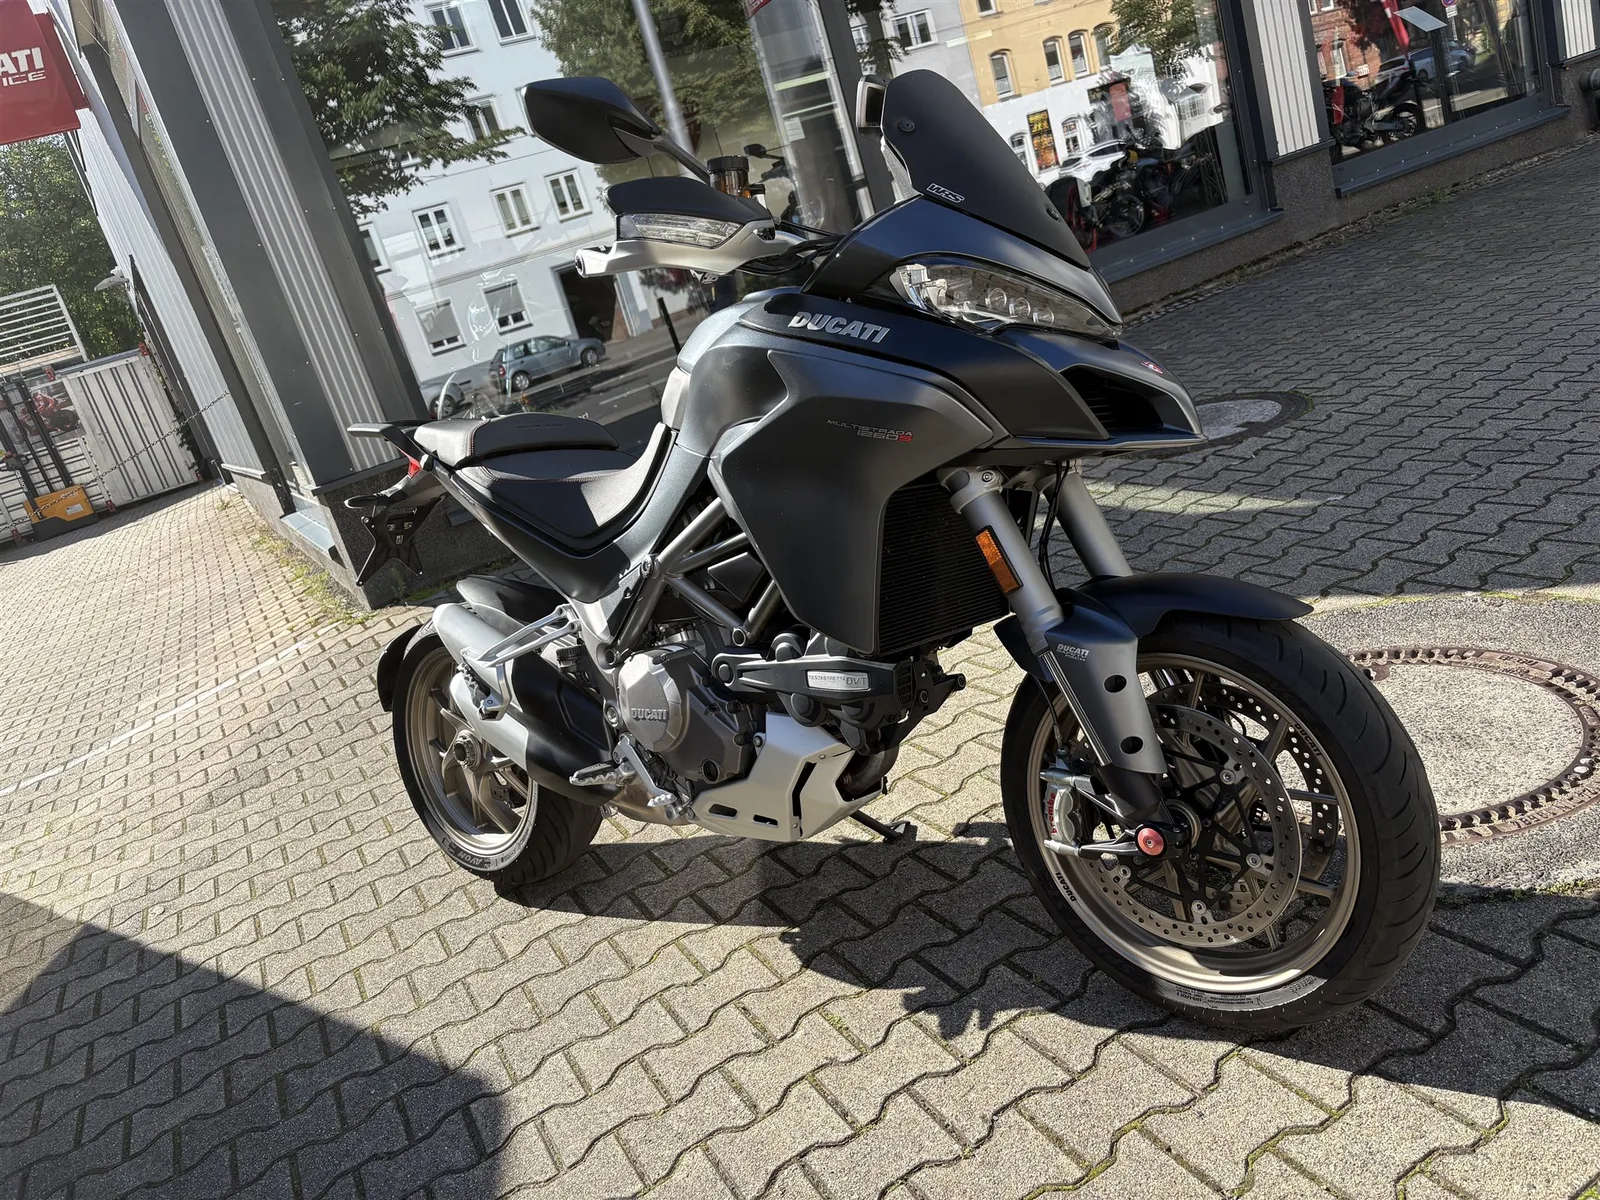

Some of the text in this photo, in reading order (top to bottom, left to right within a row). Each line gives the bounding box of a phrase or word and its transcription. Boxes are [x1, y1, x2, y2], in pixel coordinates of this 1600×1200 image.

[788, 311, 890, 344] DUCATI
[827, 420, 912, 436] MULTISTRADA
[1057, 644, 1089, 656] DUCATI
[846, 676, 866, 685] DVT
[631, 708, 667, 720] DUCATI
[1294, 723, 1322, 756] DUCATI
[1047, 793, 1058, 834] brembo
[1056, 872, 1077, 902] DUCATI
